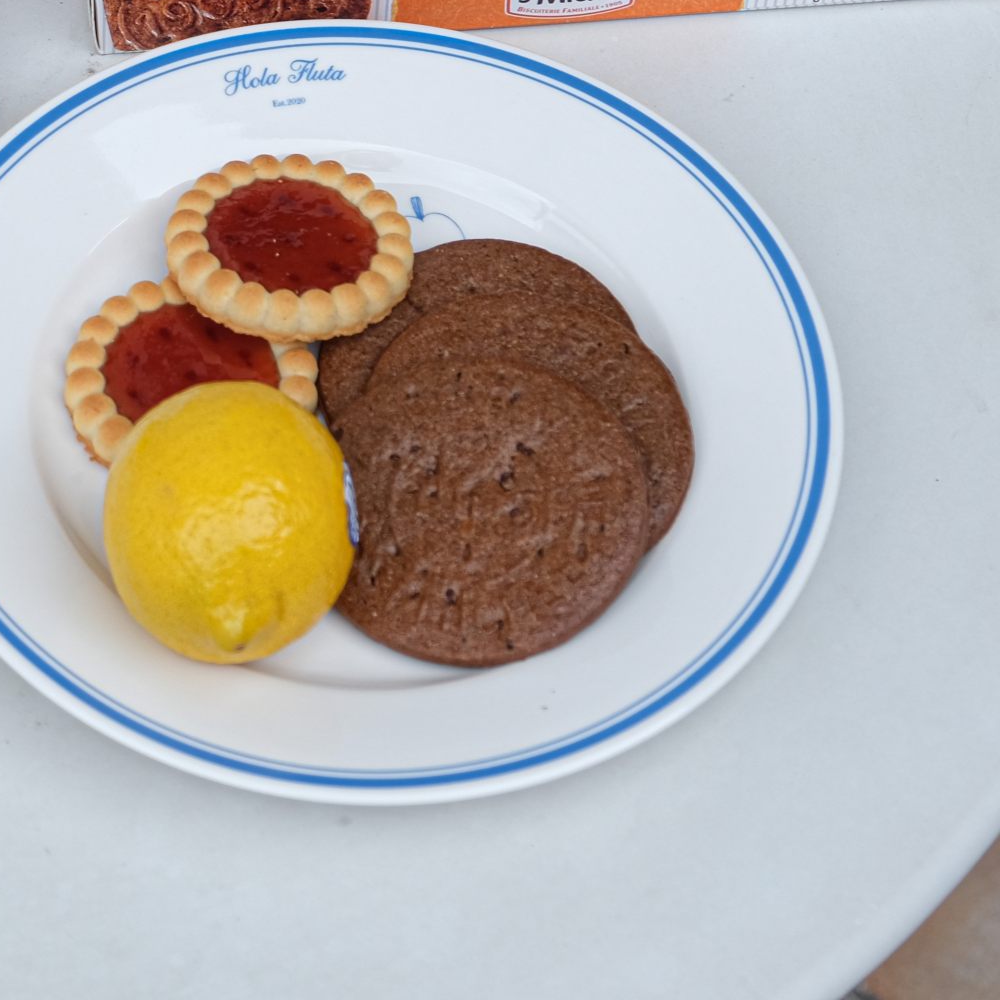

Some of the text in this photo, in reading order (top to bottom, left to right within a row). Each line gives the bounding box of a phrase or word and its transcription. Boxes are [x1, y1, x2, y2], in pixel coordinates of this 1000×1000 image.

[517, 6, 561, 15] BISCUITERIE
[562, 4, 601, 14] FAMILIALE
[223, 64, 281, 97] Hola
